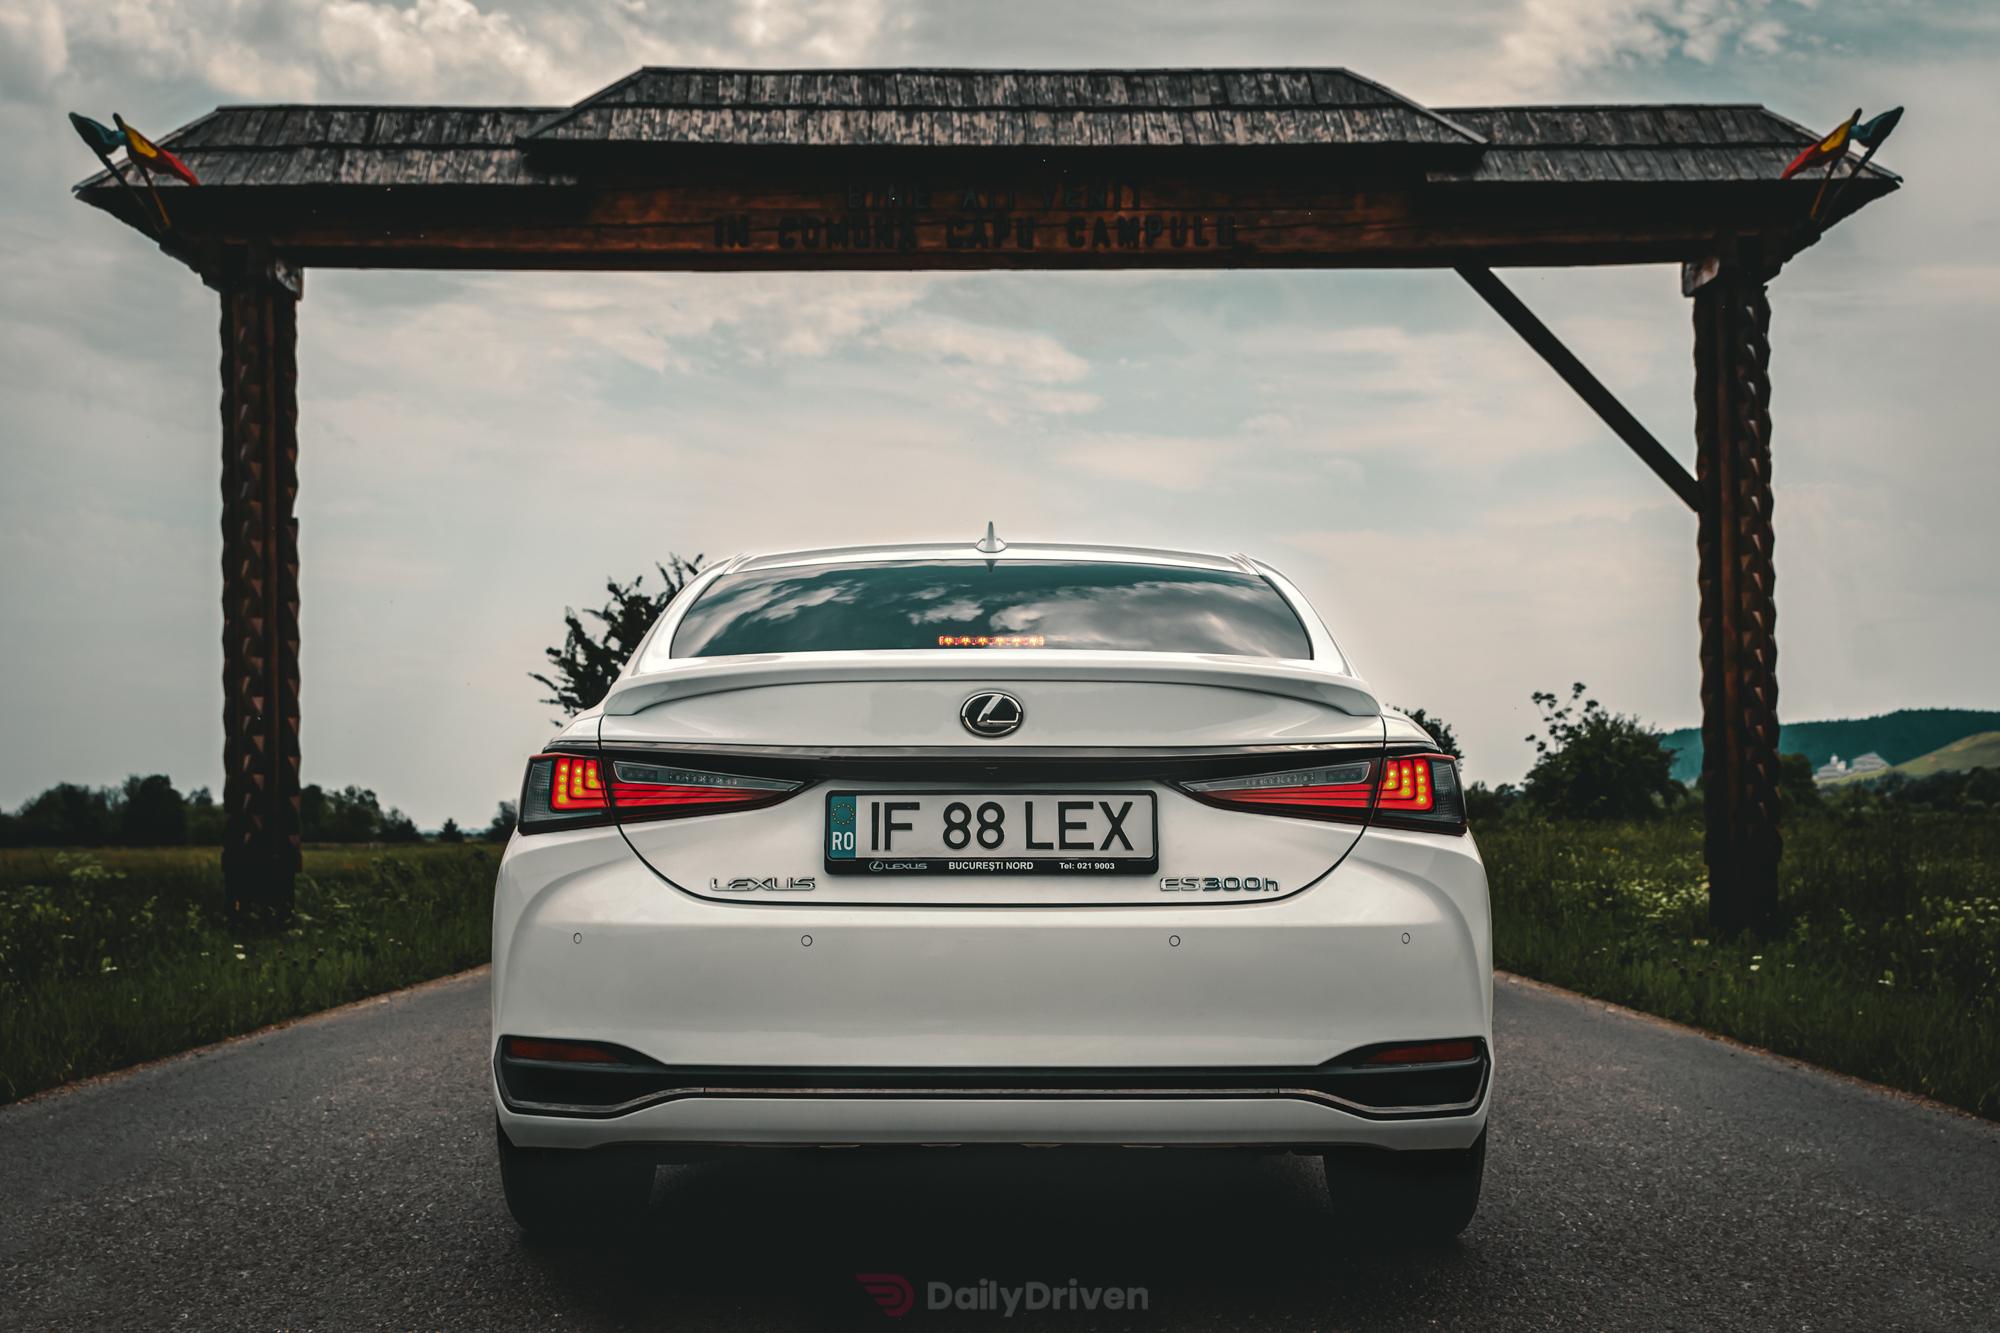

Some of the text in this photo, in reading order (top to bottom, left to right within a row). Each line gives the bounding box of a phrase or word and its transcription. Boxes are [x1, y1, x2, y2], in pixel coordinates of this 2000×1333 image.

[714, 214, 749, 249] IN
[778, 214, 912, 250] COMUNA
[945, 215, 1035, 249] CAPU
[870, 801, 1135, 851] IF 88 LEX
[832, 831, 854, 850] RO
[1005, 861, 1034, 870] NORD
[1059, 862, 1116, 870] Tel: 021 9003
[710, 877, 816, 892] LEXUS
